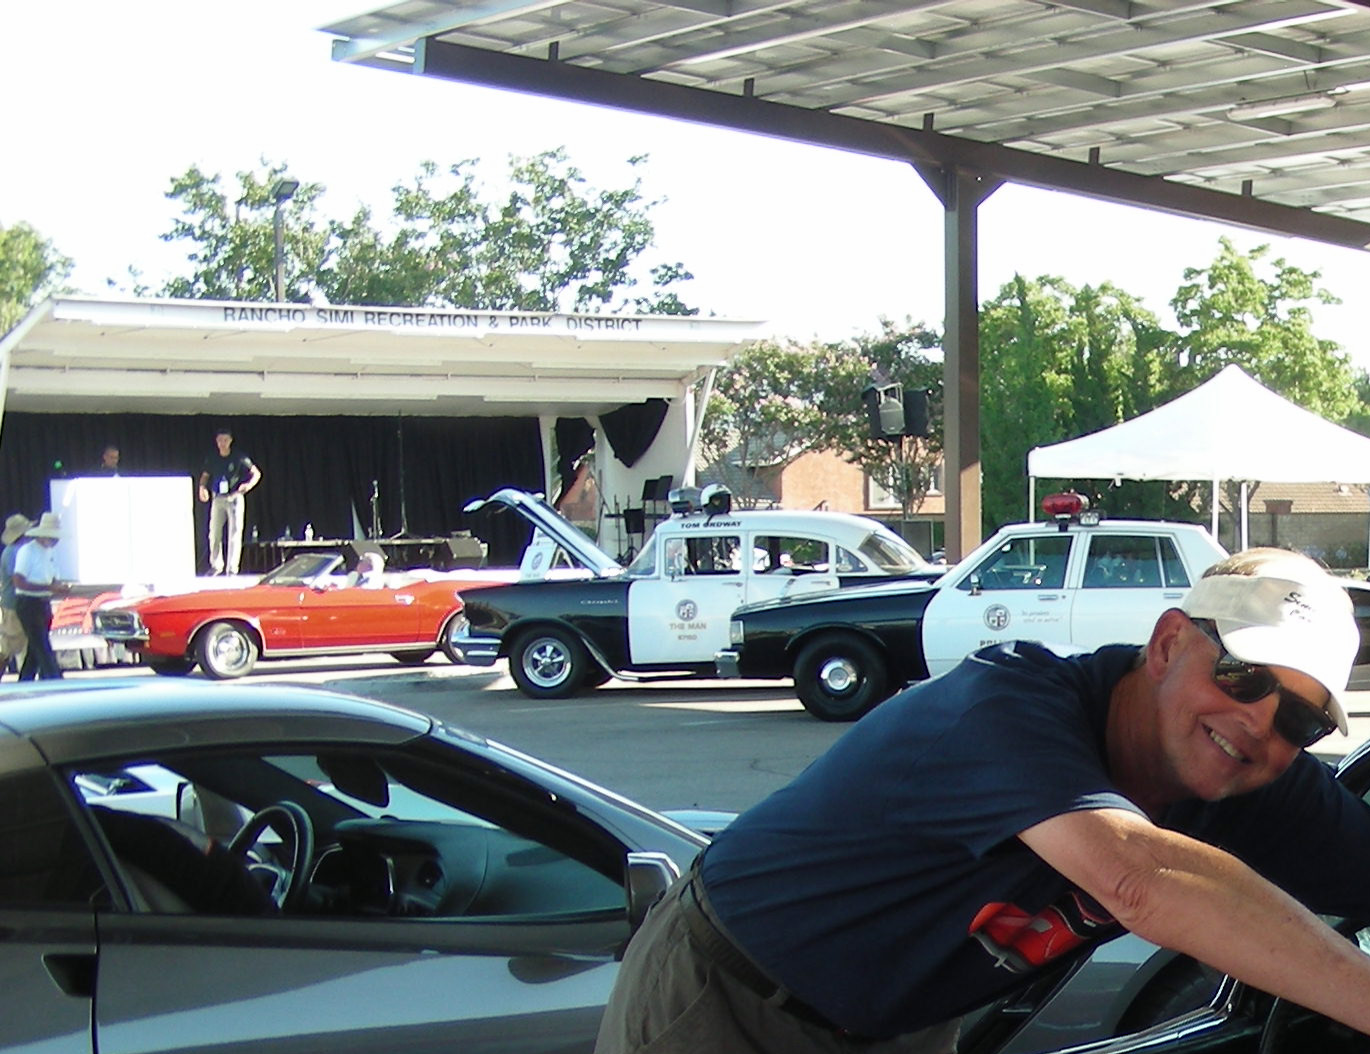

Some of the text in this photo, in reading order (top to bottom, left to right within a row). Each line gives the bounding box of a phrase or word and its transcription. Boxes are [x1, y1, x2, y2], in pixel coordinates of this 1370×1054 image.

[223, 307, 643, 331] RANCHO SIMI RECREATION & PARK DISTRICT
[687, 622, 707, 630] MAN
